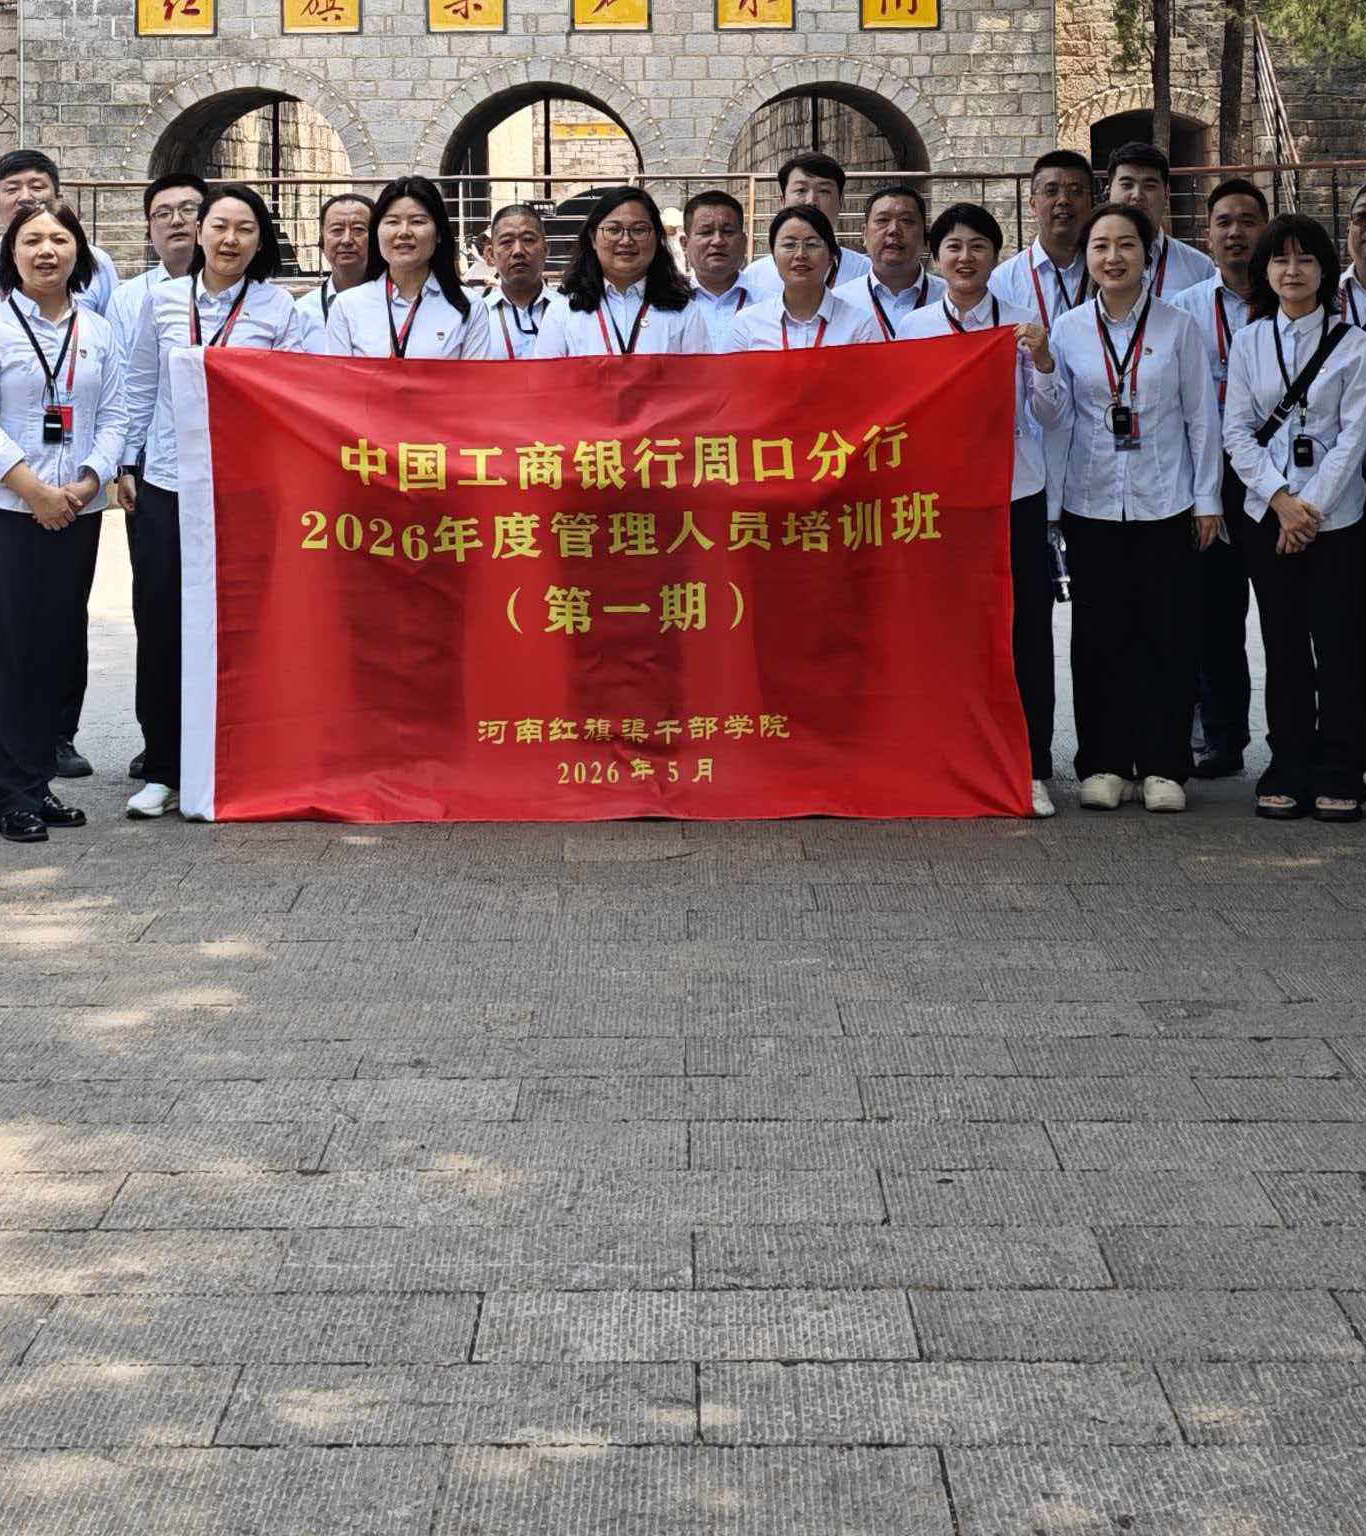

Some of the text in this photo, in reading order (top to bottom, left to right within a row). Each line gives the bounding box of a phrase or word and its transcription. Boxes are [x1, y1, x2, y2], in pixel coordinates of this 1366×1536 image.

[339, 421, 909, 492] 中国工商银行周口分行
[300, 491, 942, 562] 2026年度管理人员培训班
[477, 714, 790, 745] 河南红旗渠干部学院
